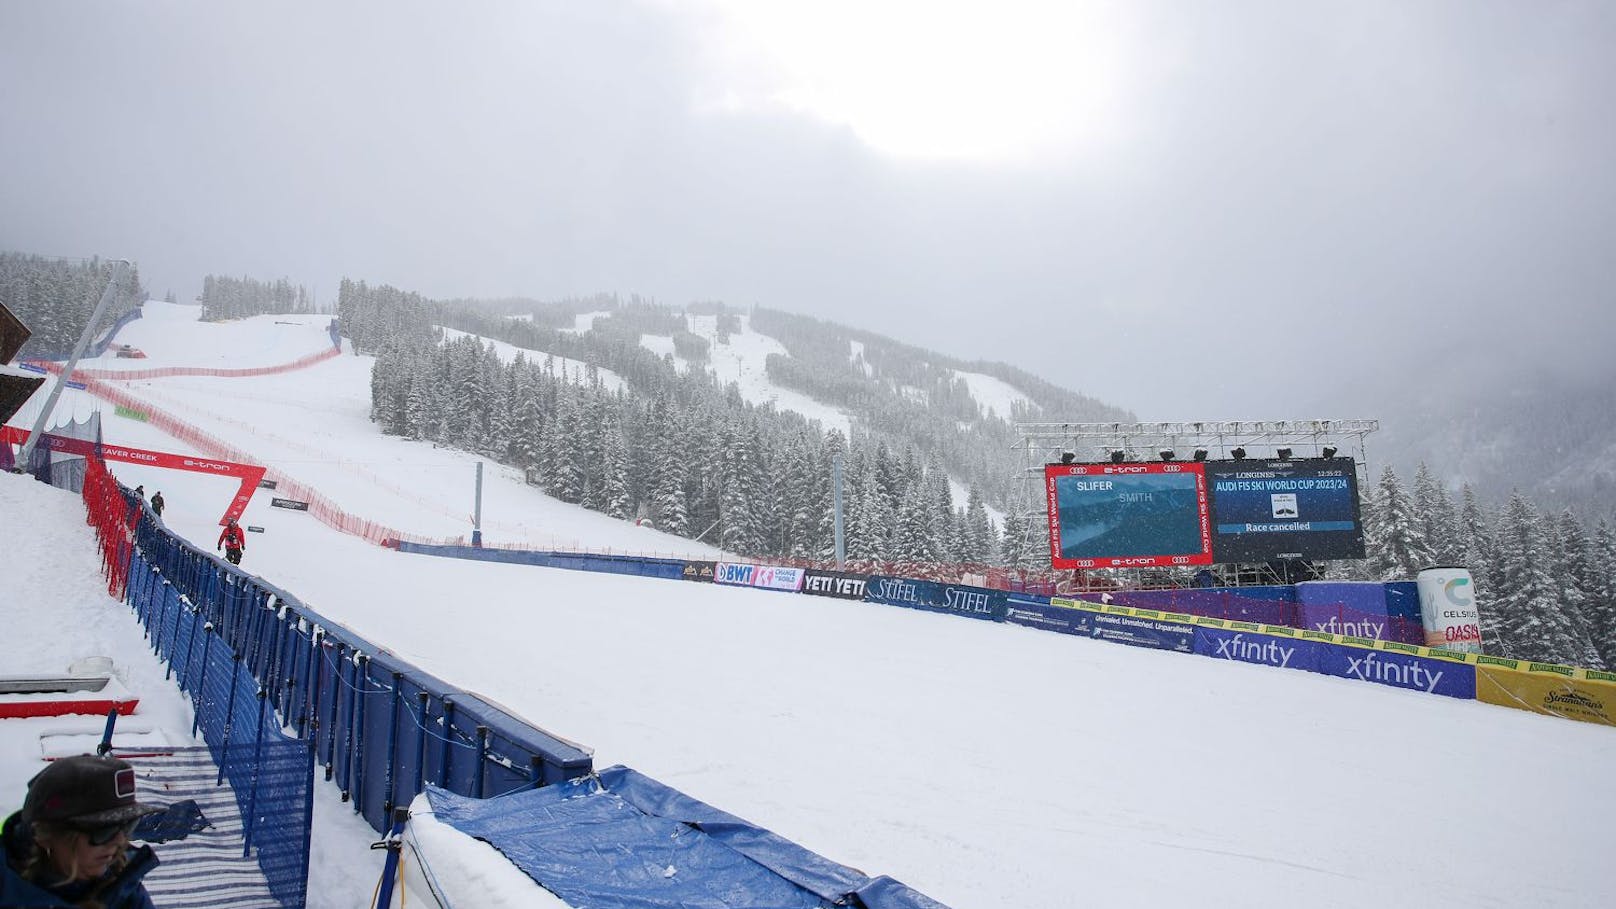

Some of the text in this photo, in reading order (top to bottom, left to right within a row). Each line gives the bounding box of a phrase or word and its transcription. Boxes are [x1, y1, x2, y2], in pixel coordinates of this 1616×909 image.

[130, 452, 158, 462] CREEK
[183, 459, 230, 472] e-tron
[1104, 466, 1148, 474] e-tron
[1236, 471, 1276, 479] LONGINES
[1076, 481, 1113, 491] SLIFER
[1216, 478, 1348, 491] AUDI FIS SKI WORLD CUP 2023/24
[1118, 493, 1153, 503] SMITH
[1245, 522, 1310, 532] Race cancelled
[1111, 557, 1155, 565] e-tron
[726, 563, 753, 583] BWT
[805, 575, 866, 596] YETI YETI
[877, 578, 918, 602] STIFEL
[942, 587, 992, 614] STIFEL
[1443, 610, 1477, 618] CELSIUS
[1095, 615, 1121, 625] Unrivaled.
[1122, 618, 1154, 630] Unmatched.
[1155, 622, 1194, 634] Unparalleled.
[1315, 616, 1385, 641] xfinity
[1215, 634, 1295, 668] xfinity
[1346, 652, 1444, 693] xfinity
